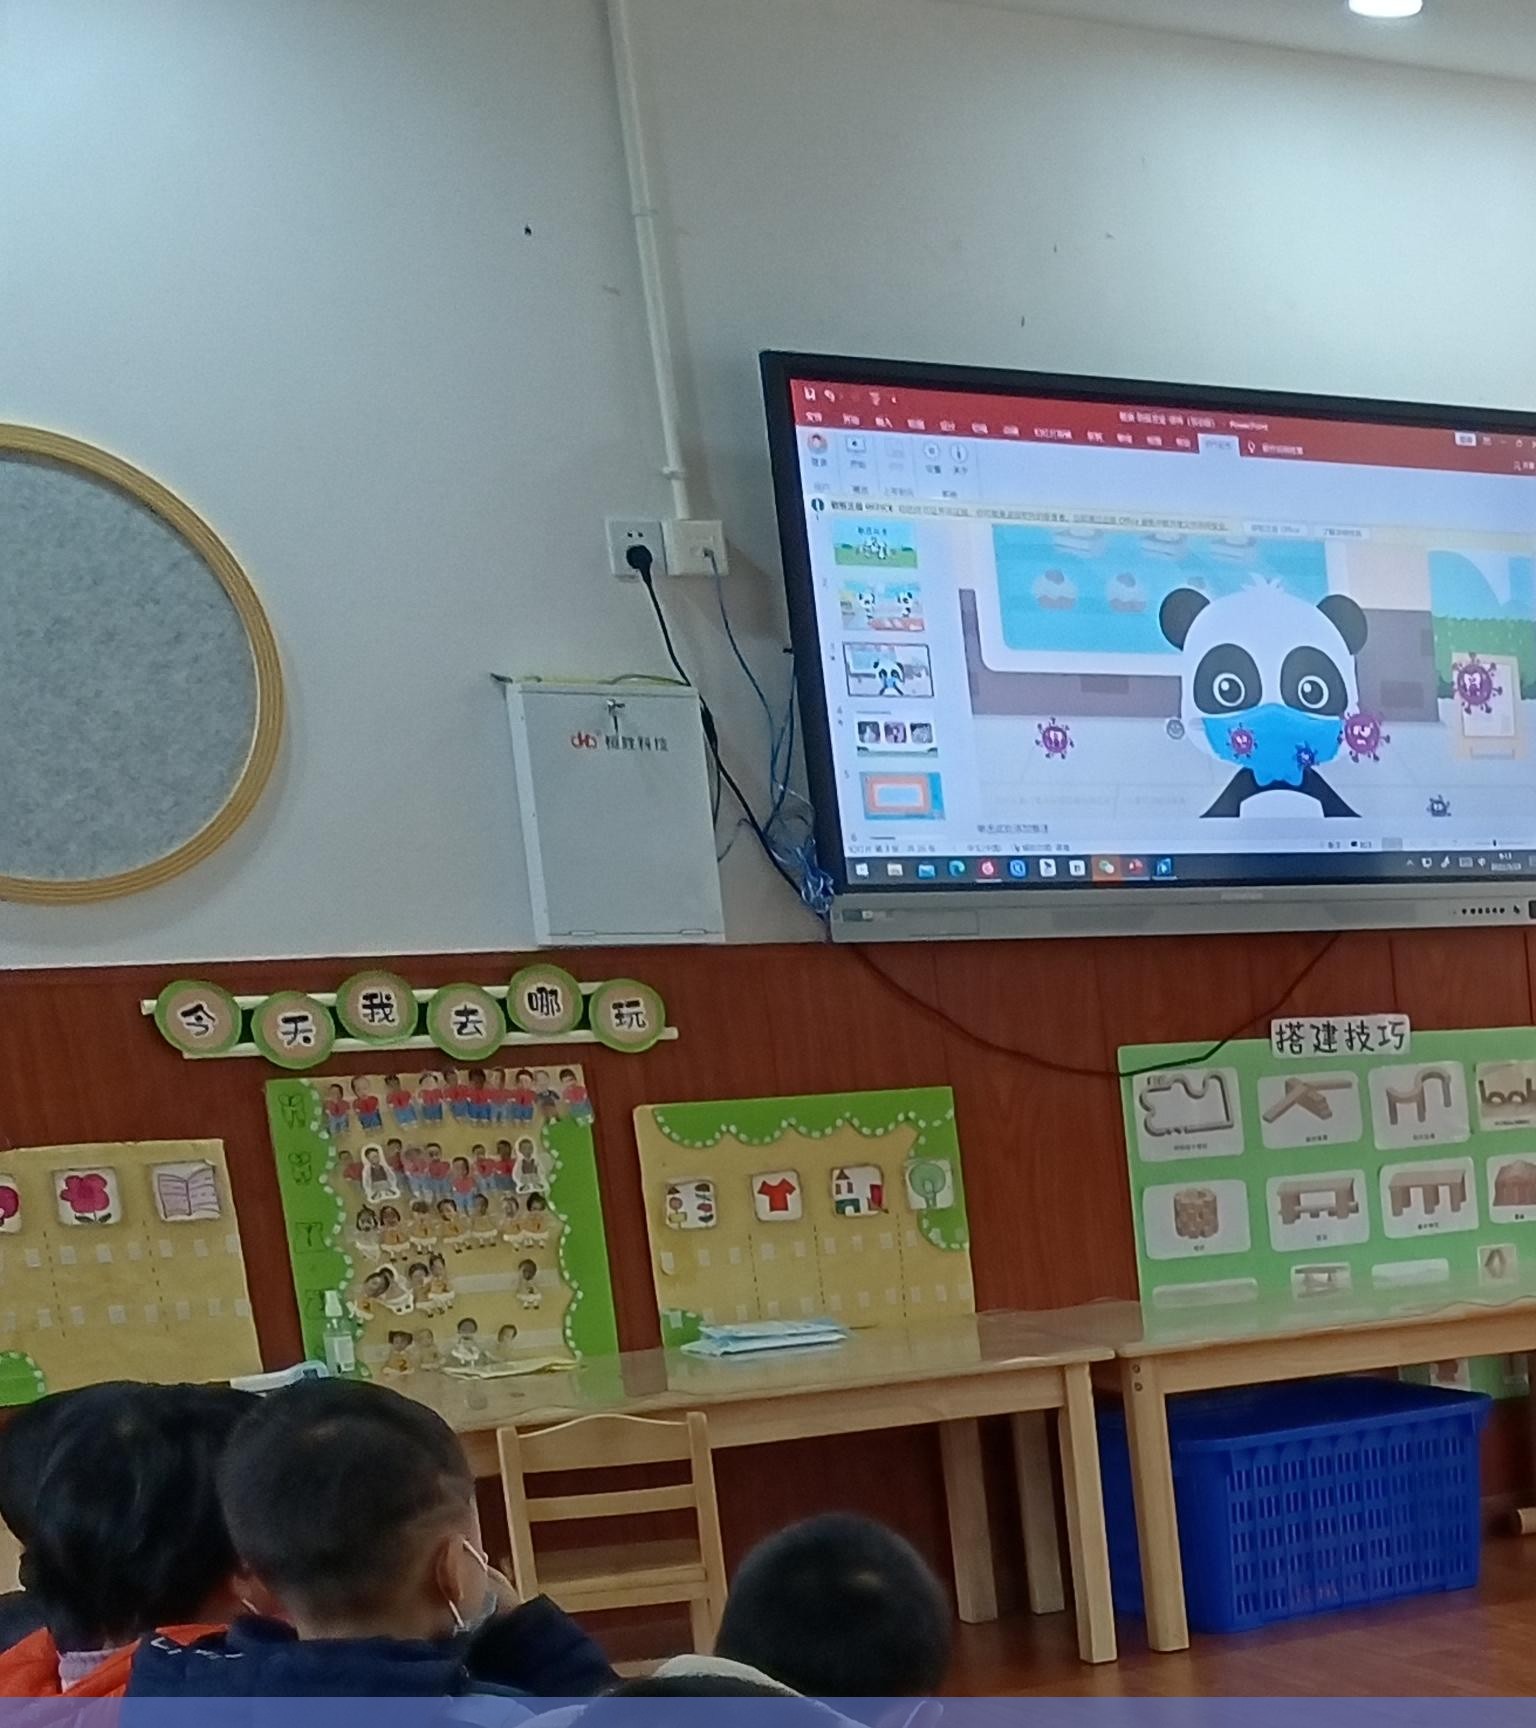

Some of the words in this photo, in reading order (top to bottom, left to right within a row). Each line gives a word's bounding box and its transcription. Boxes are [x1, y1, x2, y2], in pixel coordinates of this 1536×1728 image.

[179, 986, 650, 1047] 今天我去哪玩
[1275, 1020, 1405, 1054] 搭建技巧
